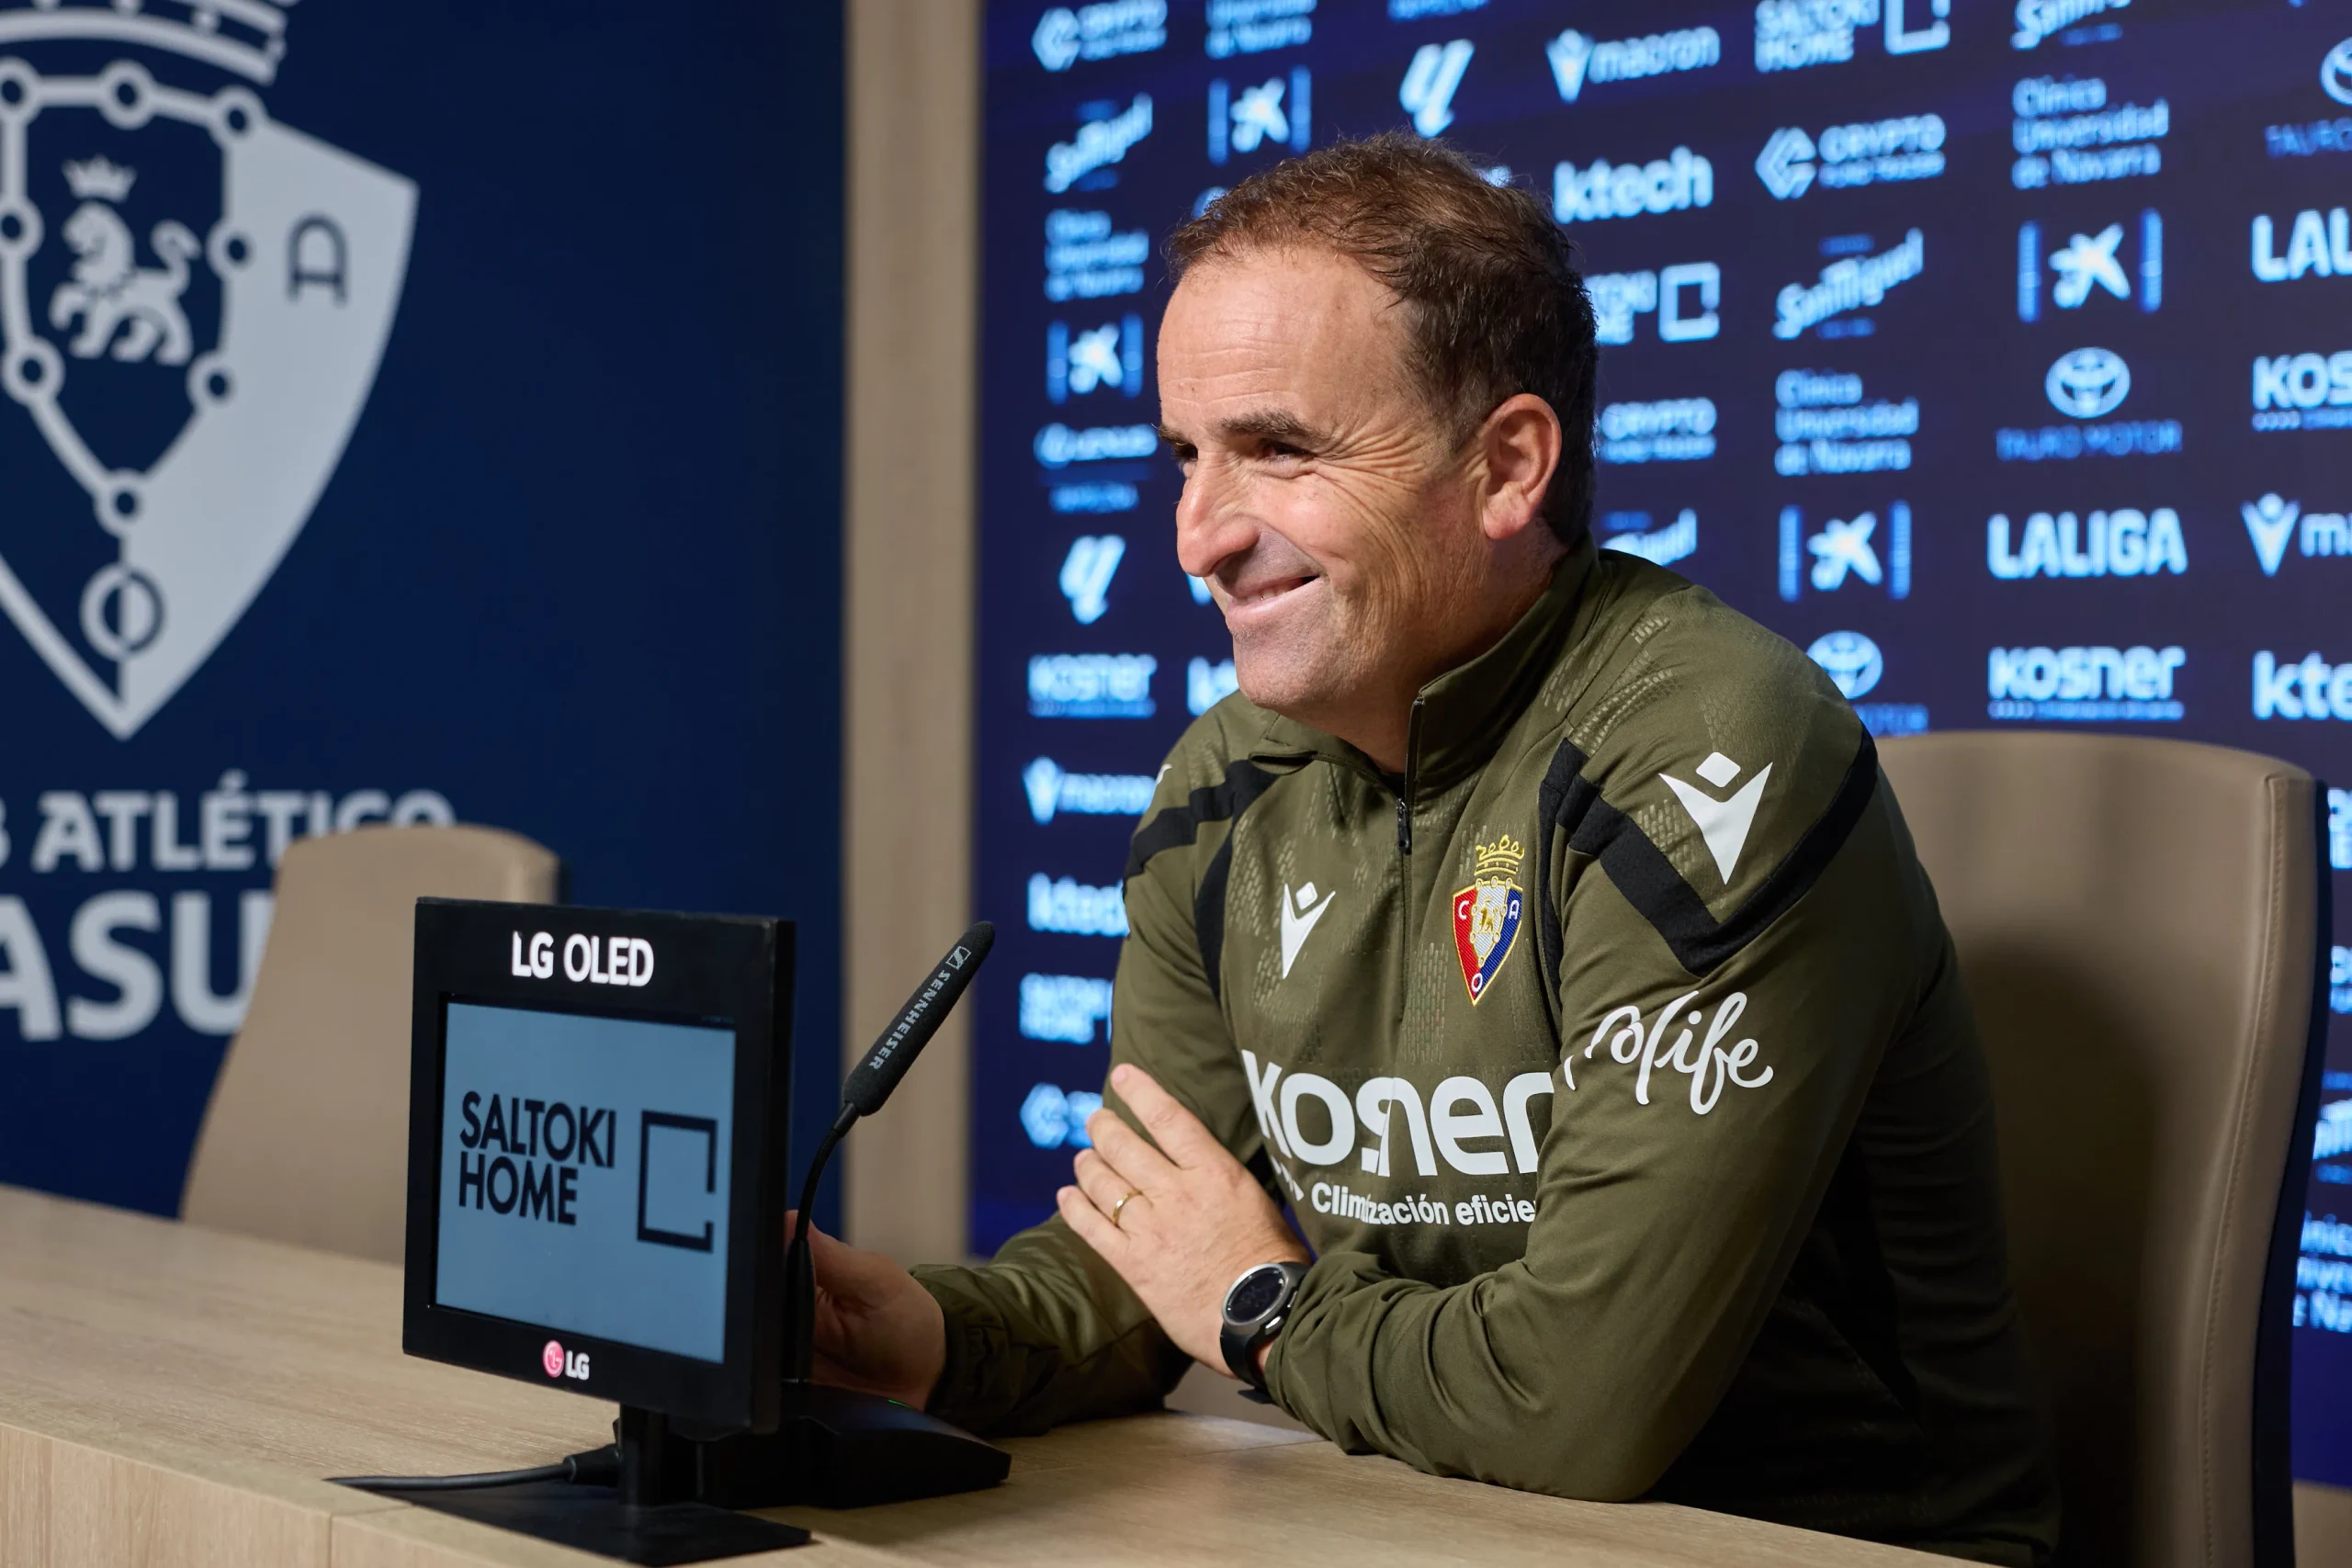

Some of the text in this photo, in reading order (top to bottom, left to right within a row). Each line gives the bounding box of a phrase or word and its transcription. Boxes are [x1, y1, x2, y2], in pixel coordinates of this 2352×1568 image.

[1553, 146, 1713, 223] ktech
[1987, 508, 2188, 580] LALIGA
[512, 931, 654, 987] LG OLED
[869, 970, 951, 1069] SENNHEISER
[459, 1090, 616, 1168] SALTOKI
[459, 1151, 578, 1226] HOME
[1454, 1193, 1536, 1225] eficie
[565, 1350, 590, 1380] LG
